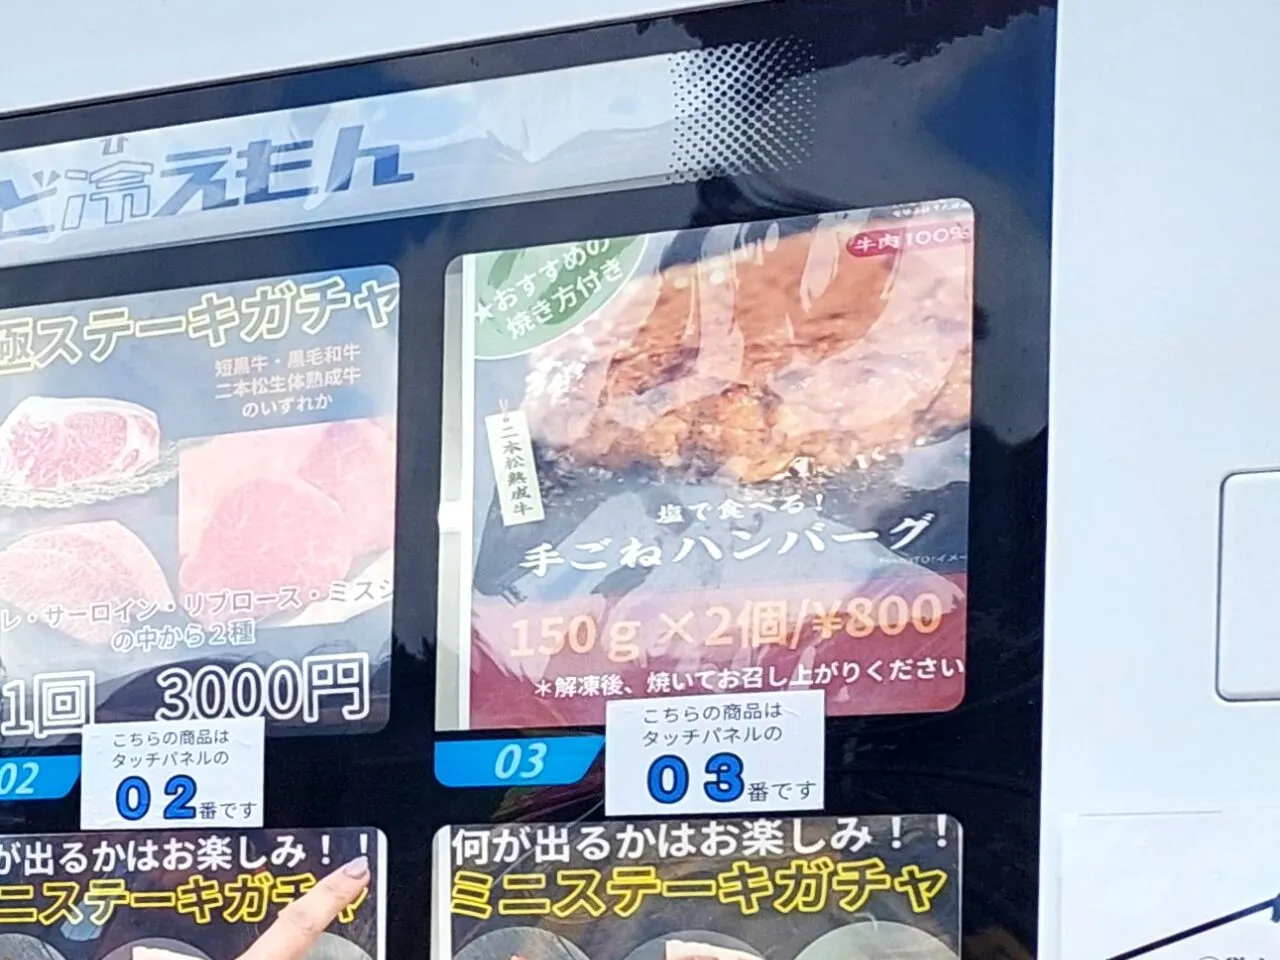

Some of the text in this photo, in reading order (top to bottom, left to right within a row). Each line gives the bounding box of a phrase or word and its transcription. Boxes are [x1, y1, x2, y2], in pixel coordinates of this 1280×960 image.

[854, 226, 969, 252] 牛肉100%
[506, 257, 623, 340] 焼き方付き
[215, 366, 361, 399] 二本松生体熟成牛
[242, 393, 333, 418] のいずれか
[520, 512, 936, 577] 手ごねハンバーグ
[112, 618, 254, 652] の中から2種
[0, 652, 370, 737] 1回 3000円
[644, 703, 781, 724] こちらの商品は
[113, 728, 229, 747] こちらの商品は
[643, 726, 781, 746] タッチパネルの
[112, 749, 229, 769] タッチパネルの
[494, 744, 547, 779] 03
[452, 816, 948, 865] 何が出るかはお楽しみ！！
[452, 857, 947, 920] ミニステーキガチャ
